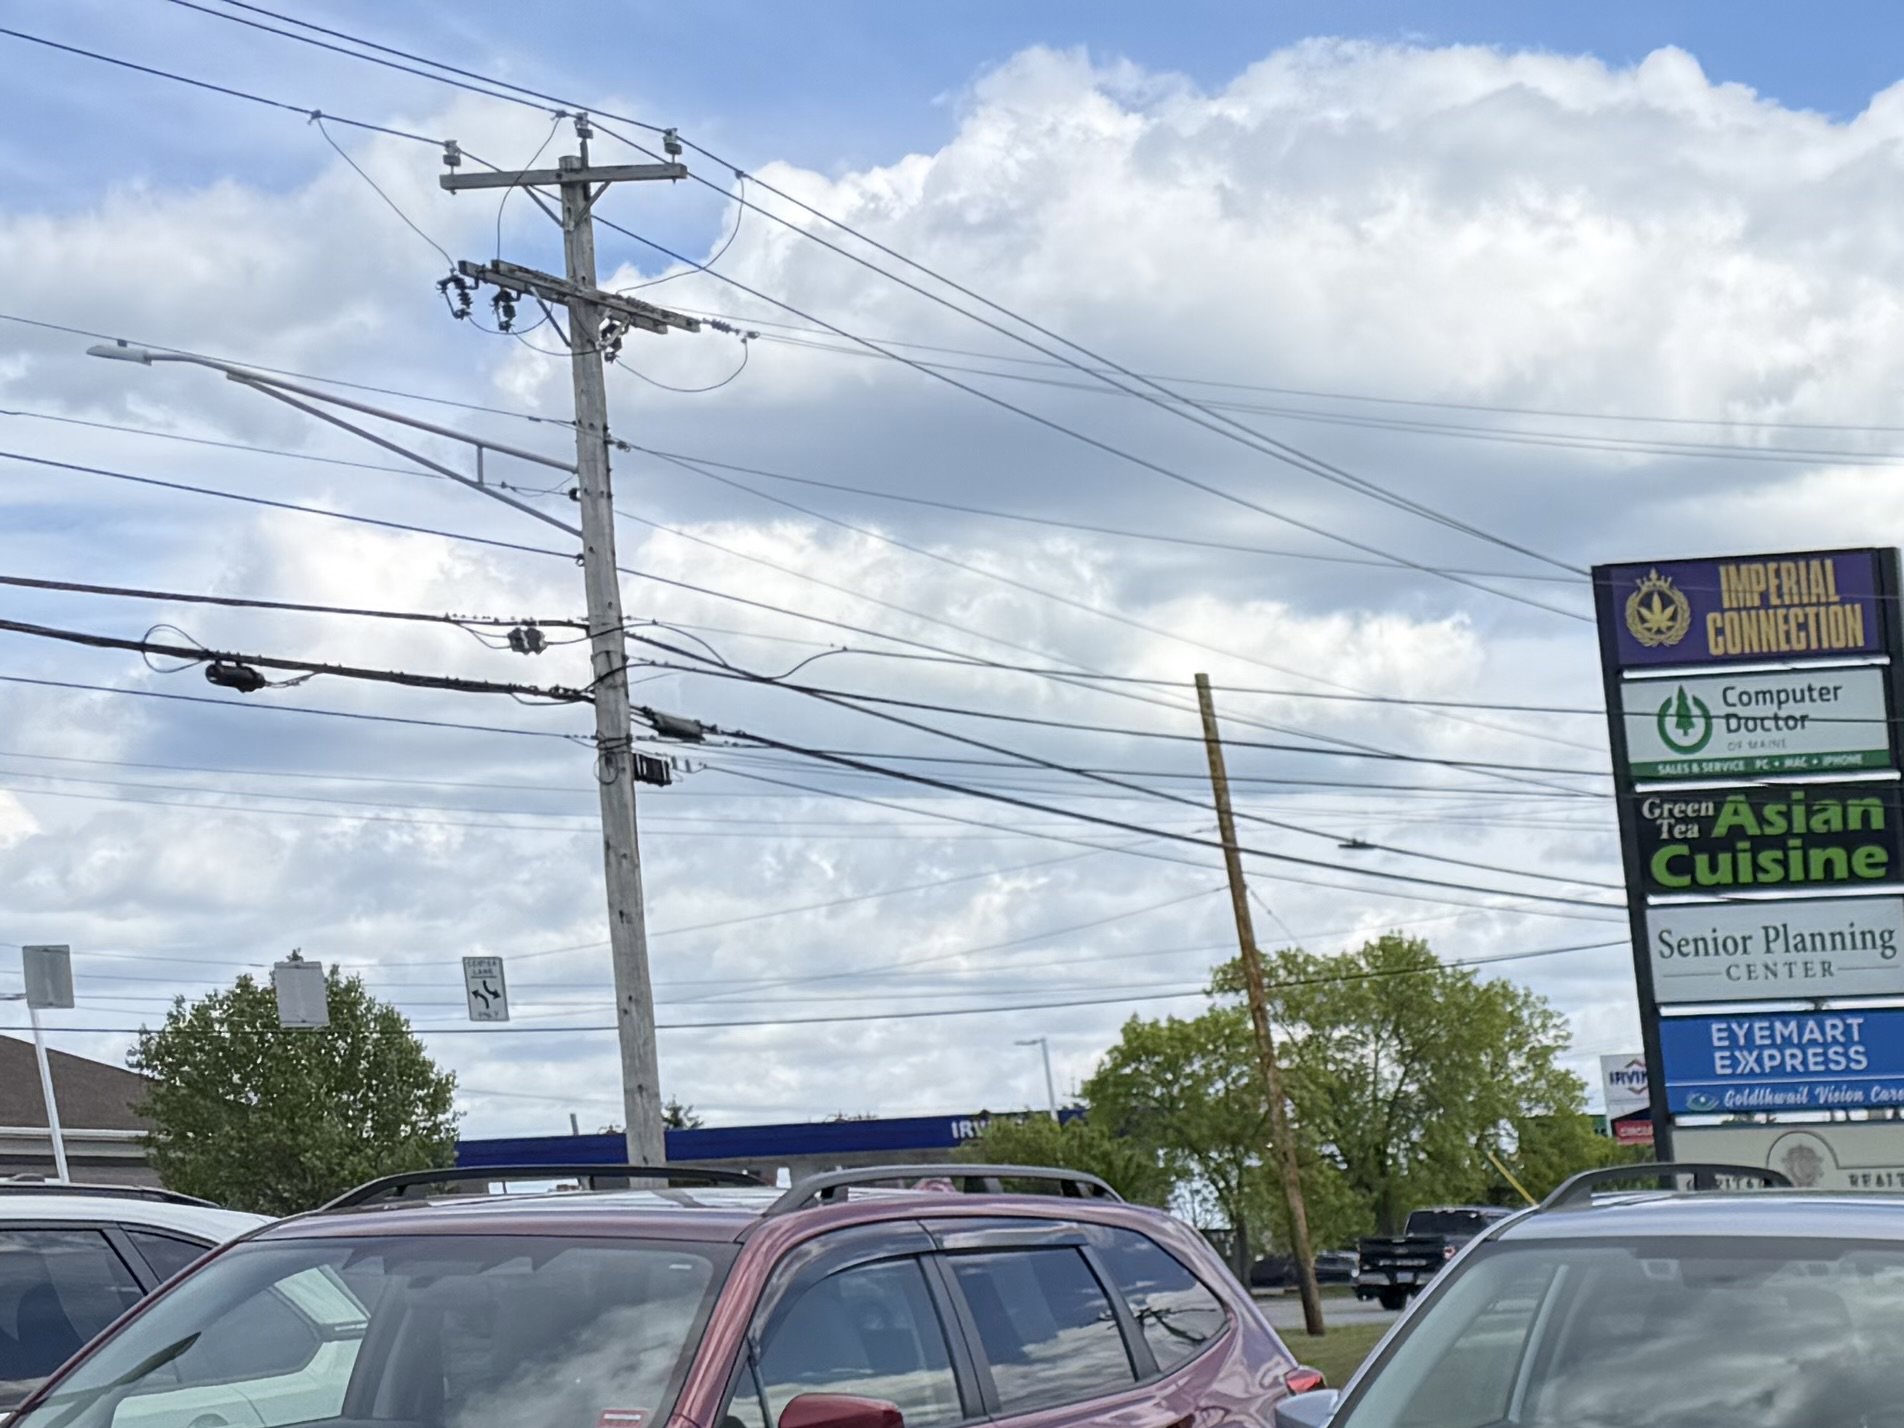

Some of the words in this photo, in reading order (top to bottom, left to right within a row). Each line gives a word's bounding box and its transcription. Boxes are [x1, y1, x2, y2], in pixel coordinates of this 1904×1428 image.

[1718, 558, 1840, 609] IMPERIAL
[1706, 603, 1865, 656] CONNECTION
[1722, 683, 1843, 711] Computer
[1724, 712, 1809, 734] Doctor
[1657, 762, 1690, 775] SALES
[1701, 760, 1745, 774] SERVICE
[1755, 758, 1770, 770] PC
[1783, 756, 1808, 768] MAC
[1642, 797, 1715, 820] Green
[1711, 791, 1886, 838] Asian
[1656, 818, 1700, 840] Tea
[1650, 838, 1889, 888] Cuisine
[1658, 927, 1754, 960] Senior
[1761, 922, 1898, 960] Planning
[1725, 960, 1835, 982] CENTER
[1711, 1017, 1864, 1048] EYEMART
[1714, 1044, 1869, 1075] EXPRESS
[1609, 1070, 1648, 1086] IRVI
[1814, 1084, 1864, 1105] Vision
[951, 1118, 993, 1139] IRV
